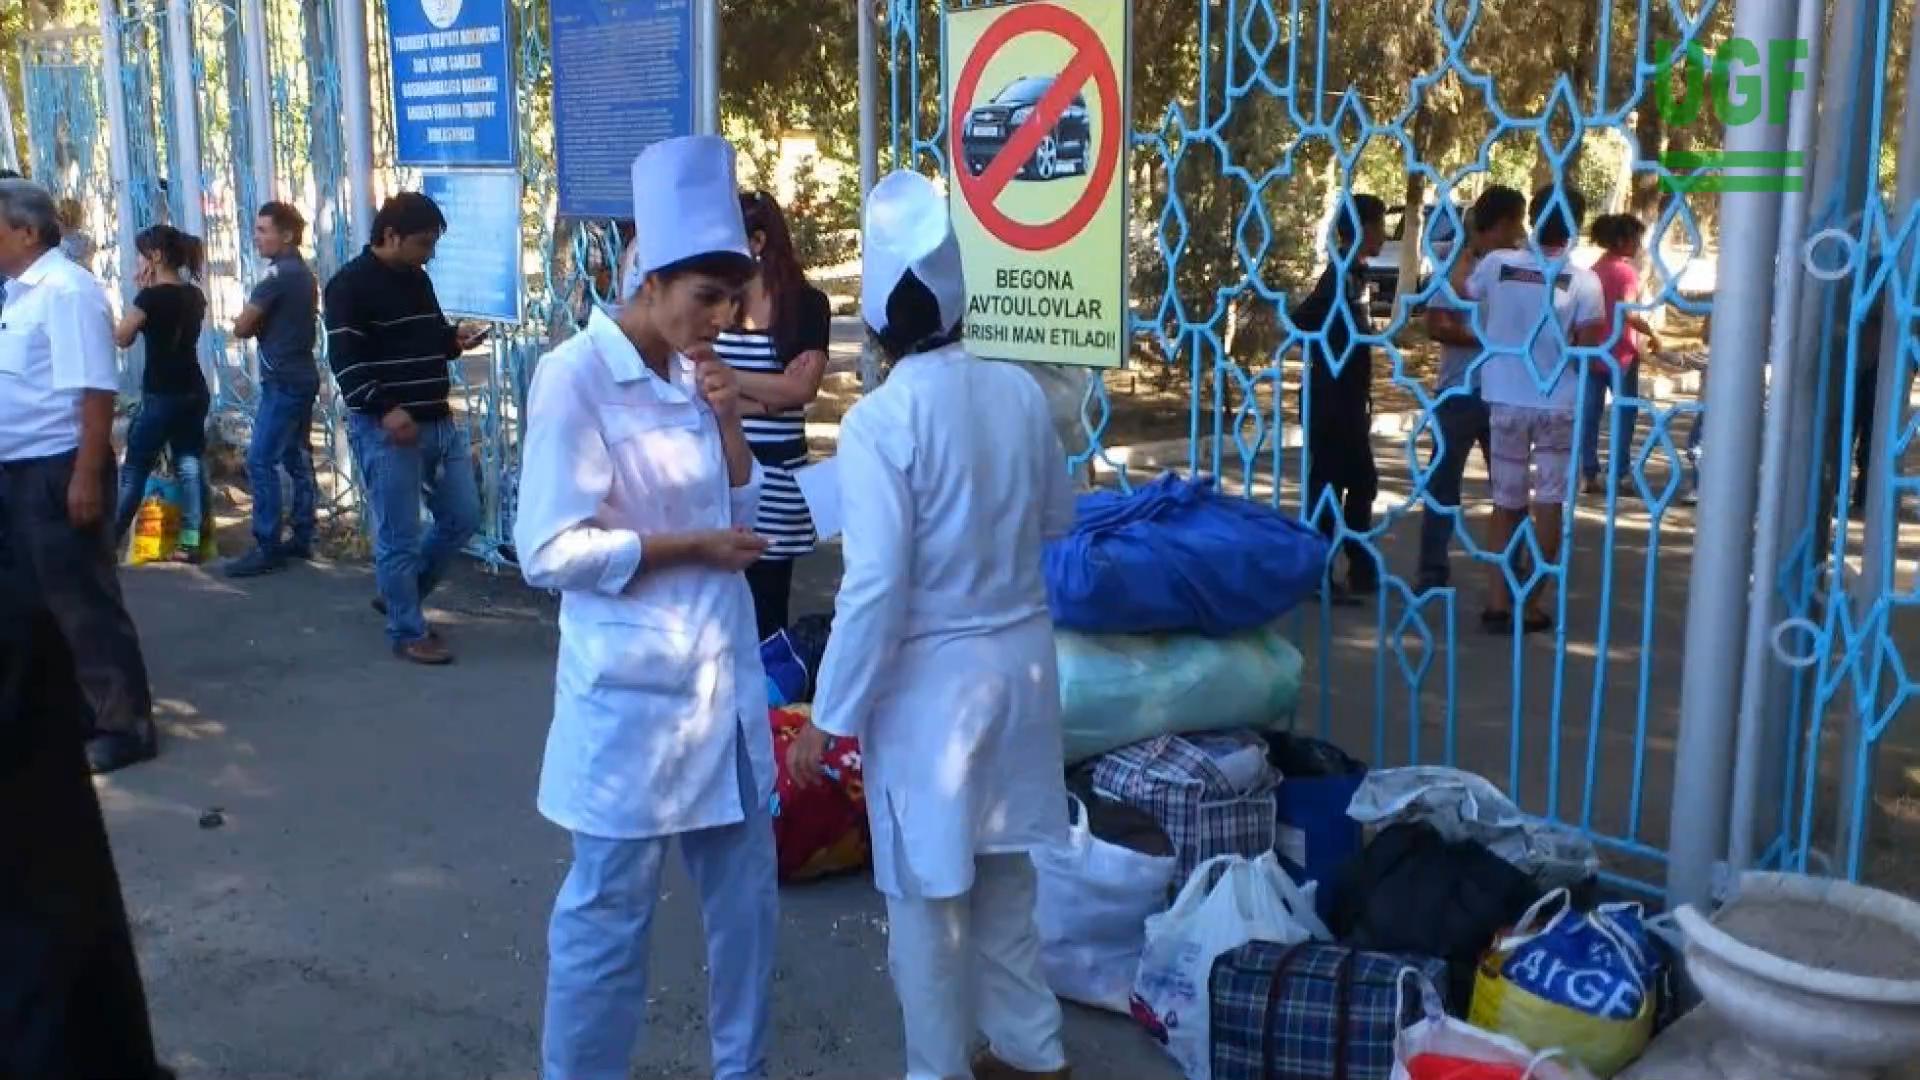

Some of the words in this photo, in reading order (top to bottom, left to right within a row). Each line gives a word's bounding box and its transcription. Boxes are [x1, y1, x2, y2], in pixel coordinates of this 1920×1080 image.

[996, 269, 1074, 290] BEGONA
[968, 295, 1102, 319] AVTOULOVLAR
[963, 324, 1008, 342] IRISHI
[1012, 325, 1045, 344] MAN
